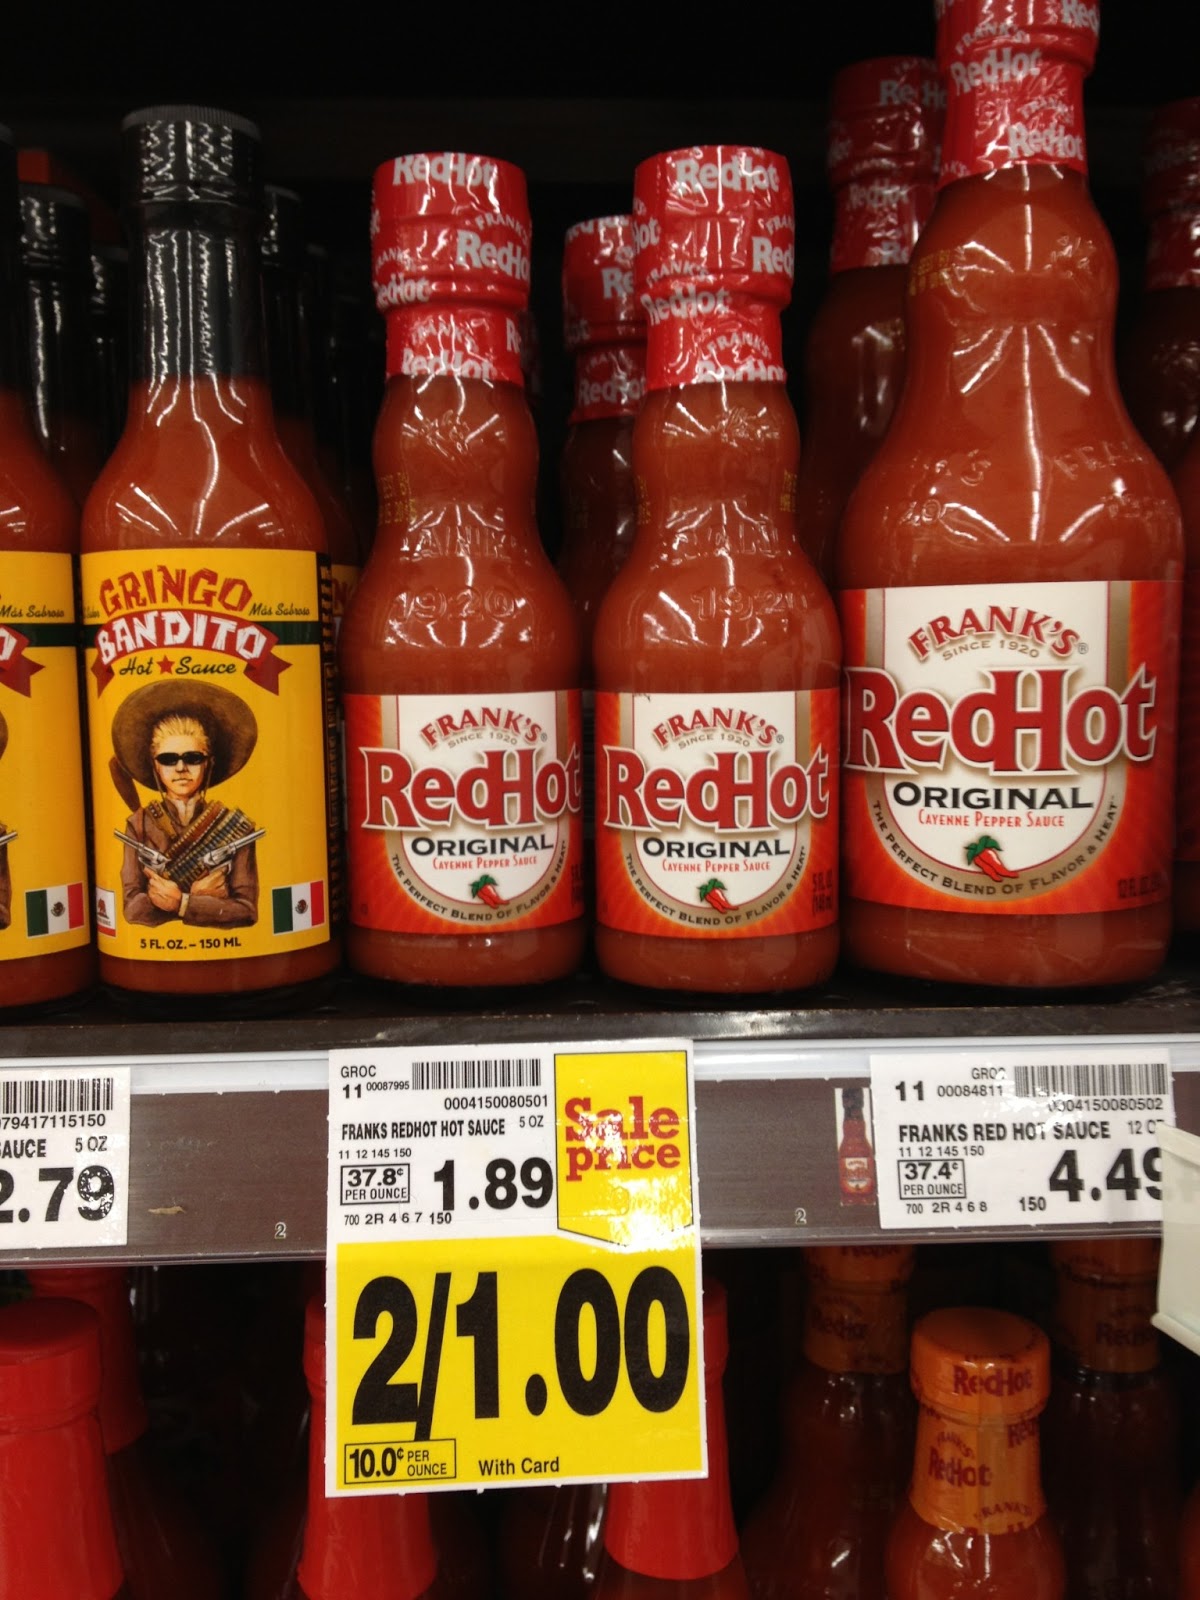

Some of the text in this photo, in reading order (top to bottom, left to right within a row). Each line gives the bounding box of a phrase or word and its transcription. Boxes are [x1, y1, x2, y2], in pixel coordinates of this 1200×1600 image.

[951, 48, 1042, 95] RedHot
[1008, 121, 1084, 160] RedHot
[392, 152, 499, 190] RedHot
[675, 155, 779, 195] RedHot
[640, 283, 732, 326] RedHot
[99, 564, 252, 618] GRINGO
[248, 602, 272, 616] Más
[97, 610, 267, 665] BANDITO
[908, 604, 1080, 661] FRANK'S
[942, 640, 1039, 661] SINCE 1920
[119, 655, 236, 676] Hot Sauce
[420, 706, 543, 748] FRANK'S
[652, 706, 778, 747] FRANK'S
[843, 662, 1157, 776] RedHot
[447, 731, 518, 749] SINCE 1920
[678, 733, 750, 750] SINCE 1920
[358, 741, 583, 832] RedHot
[602, 742, 830, 832] RedHot
[893, 781, 1095, 810] ORIGINAL
[974, 810, 1022, 828] PEPPER
[1026, 810, 1065, 828] SAUCE
[411, 833, 554, 857] ORIGINAL
[642, 837, 790, 858] ORIGINAL
[872, 800, 888, 832] THE
[885, 832, 938, 882] PERFECT
[941, 877, 996, 896] BLEND
[1001, 882, 1024, 895] OF
[1030, 854, 1087, 890] FLAVOR
[403, 878, 448, 915] PERFECT
[450, 908, 493, 922] BLEND
[496, 908, 513, 919] OF
[516, 883, 551, 914] FLAVOR
[635, 878, 676, 916] PERFECT
[678, 912, 721, 926] BLEND
[725, 915, 742, 924] OF
[746, 889, 786, 920] FLAVOR
[140, 938, 147, 949] 5
[151, 938, 165, 950] FL.
[167, 938, 187, 950] OZ.
[200, 938, 221, 949] 150
[224, 937, 241, 949] ML
[340, 1065, 377, 1078] GROC
[342, 1081, 410, 1099] 11 00087995
[444, 1094, 548, 1110] 0004150080501
[895, 1080, 1003, 1101] 11 00084811
[0, 1113, 106, 1130] 79417115150
[342, 1115, 545, 1140] FRANKS REDHOT HOT SAUCE 5 OZ
[565, 1095, 680, 1142] Sale
[899, 1123, 968, 1142] FRANKS
[973, 1123, 1007, 1141] RED
[1012, 1122, 1047, 1140] HOT
[1053, 1120, 1112, 1139] SAUCE
[1128, 1120, 1143, 1134] 12
[0, 1135, 108, 1159] AUCE 5 OZ
[339, 1147, 412, 1160] 11 12 145 150
[899, 1145, 985, 1157] 11 12 145 150
[565, 1143, 681, 1182] price
[345, 1187, 407, 1201] PER OUNCE
[433, 1157, 555, 1211] 1.89
[904, 1182, 963, 1196] PER OUNCE
[906, 1201, 988, 1215] 700 2R 4 6 8
[1018, 1196, 1047, 1212] 150
[344, 1211, 452, 1226] 700 2R 4 6 7 150
[274, 1222, 287, 1240] 2
[352, 1265, 690, 1441] 2/1.00
[953, 1364, 1033, 1397] RedHot
[407, 1450, 430, 1463] PER
[478, 1457, 560, 1477] With Card
[928, 1446, 992, 1488] RedHot
[407, 1462, 447, 1477] OUNCE
